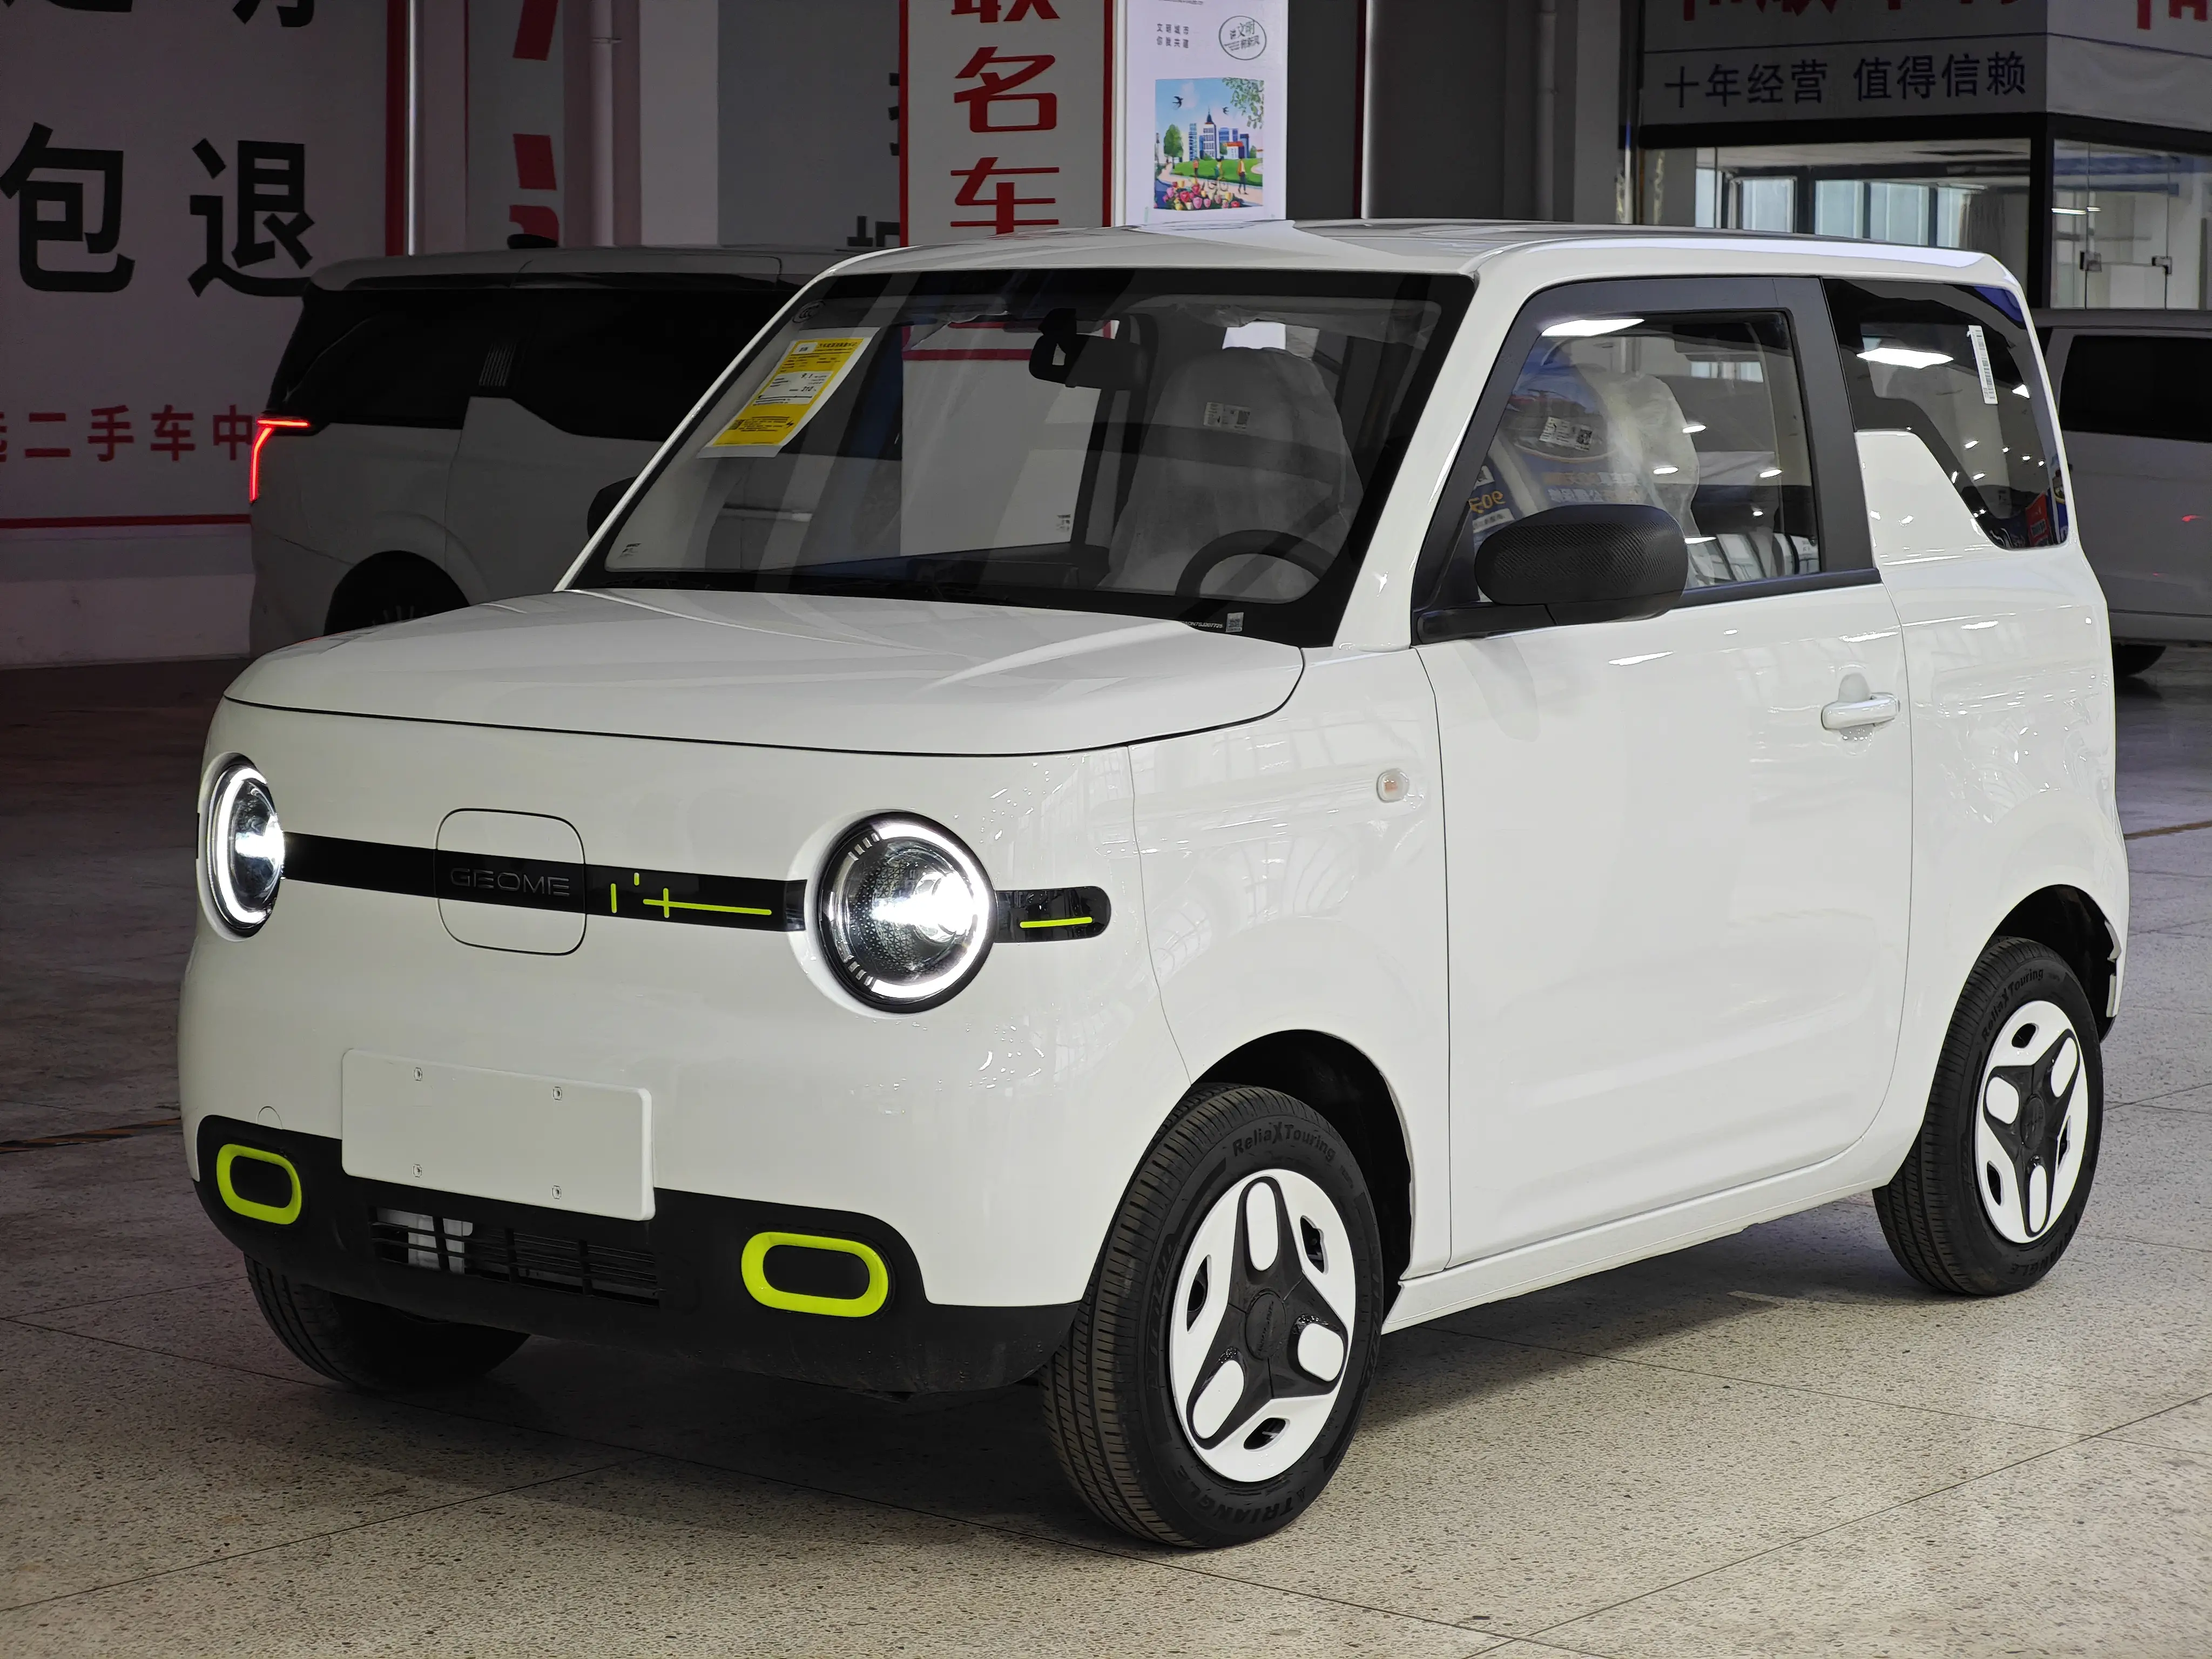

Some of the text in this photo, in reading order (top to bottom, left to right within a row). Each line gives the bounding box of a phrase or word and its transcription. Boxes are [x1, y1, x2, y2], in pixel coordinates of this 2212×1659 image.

[1664, 50, 2027, 109] 十年经营 值得信赖
[950, 0, 1061, 235] 名车
[0, 122, 315, 298] 包退
[0, 404, 254, 462] 二手车中
[449, 867, 570, 897] GEOME
